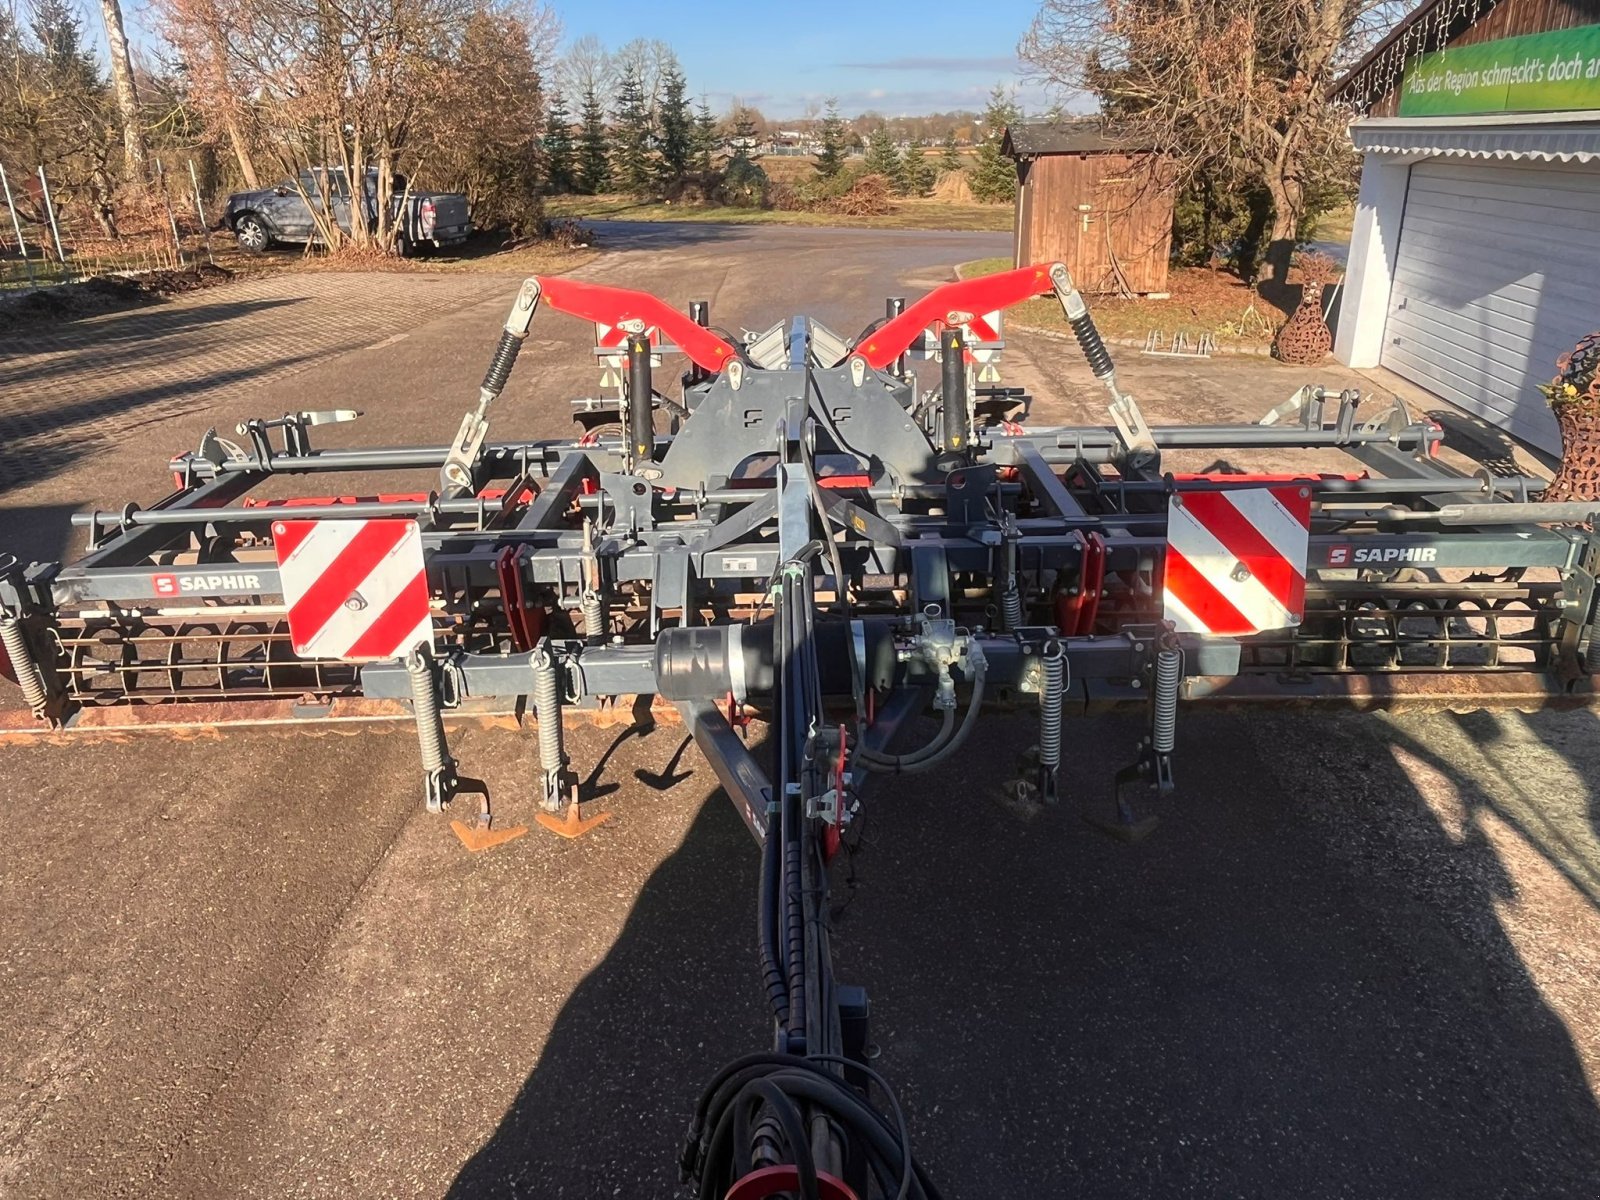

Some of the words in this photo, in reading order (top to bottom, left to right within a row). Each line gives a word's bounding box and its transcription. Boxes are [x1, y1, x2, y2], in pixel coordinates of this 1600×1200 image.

[1409, 73, 1425, 94] Aus
[1427, 71, 1443, 92] der
[1445, 68, 1478, 96] Region
[1481, 57, 1543, 87] schmeckt's
[1548, 51, 1582, 81] doch
[1354, 547, 1437, 562] SAPHIR
[180, 575, 261, 591] SAPHIR
